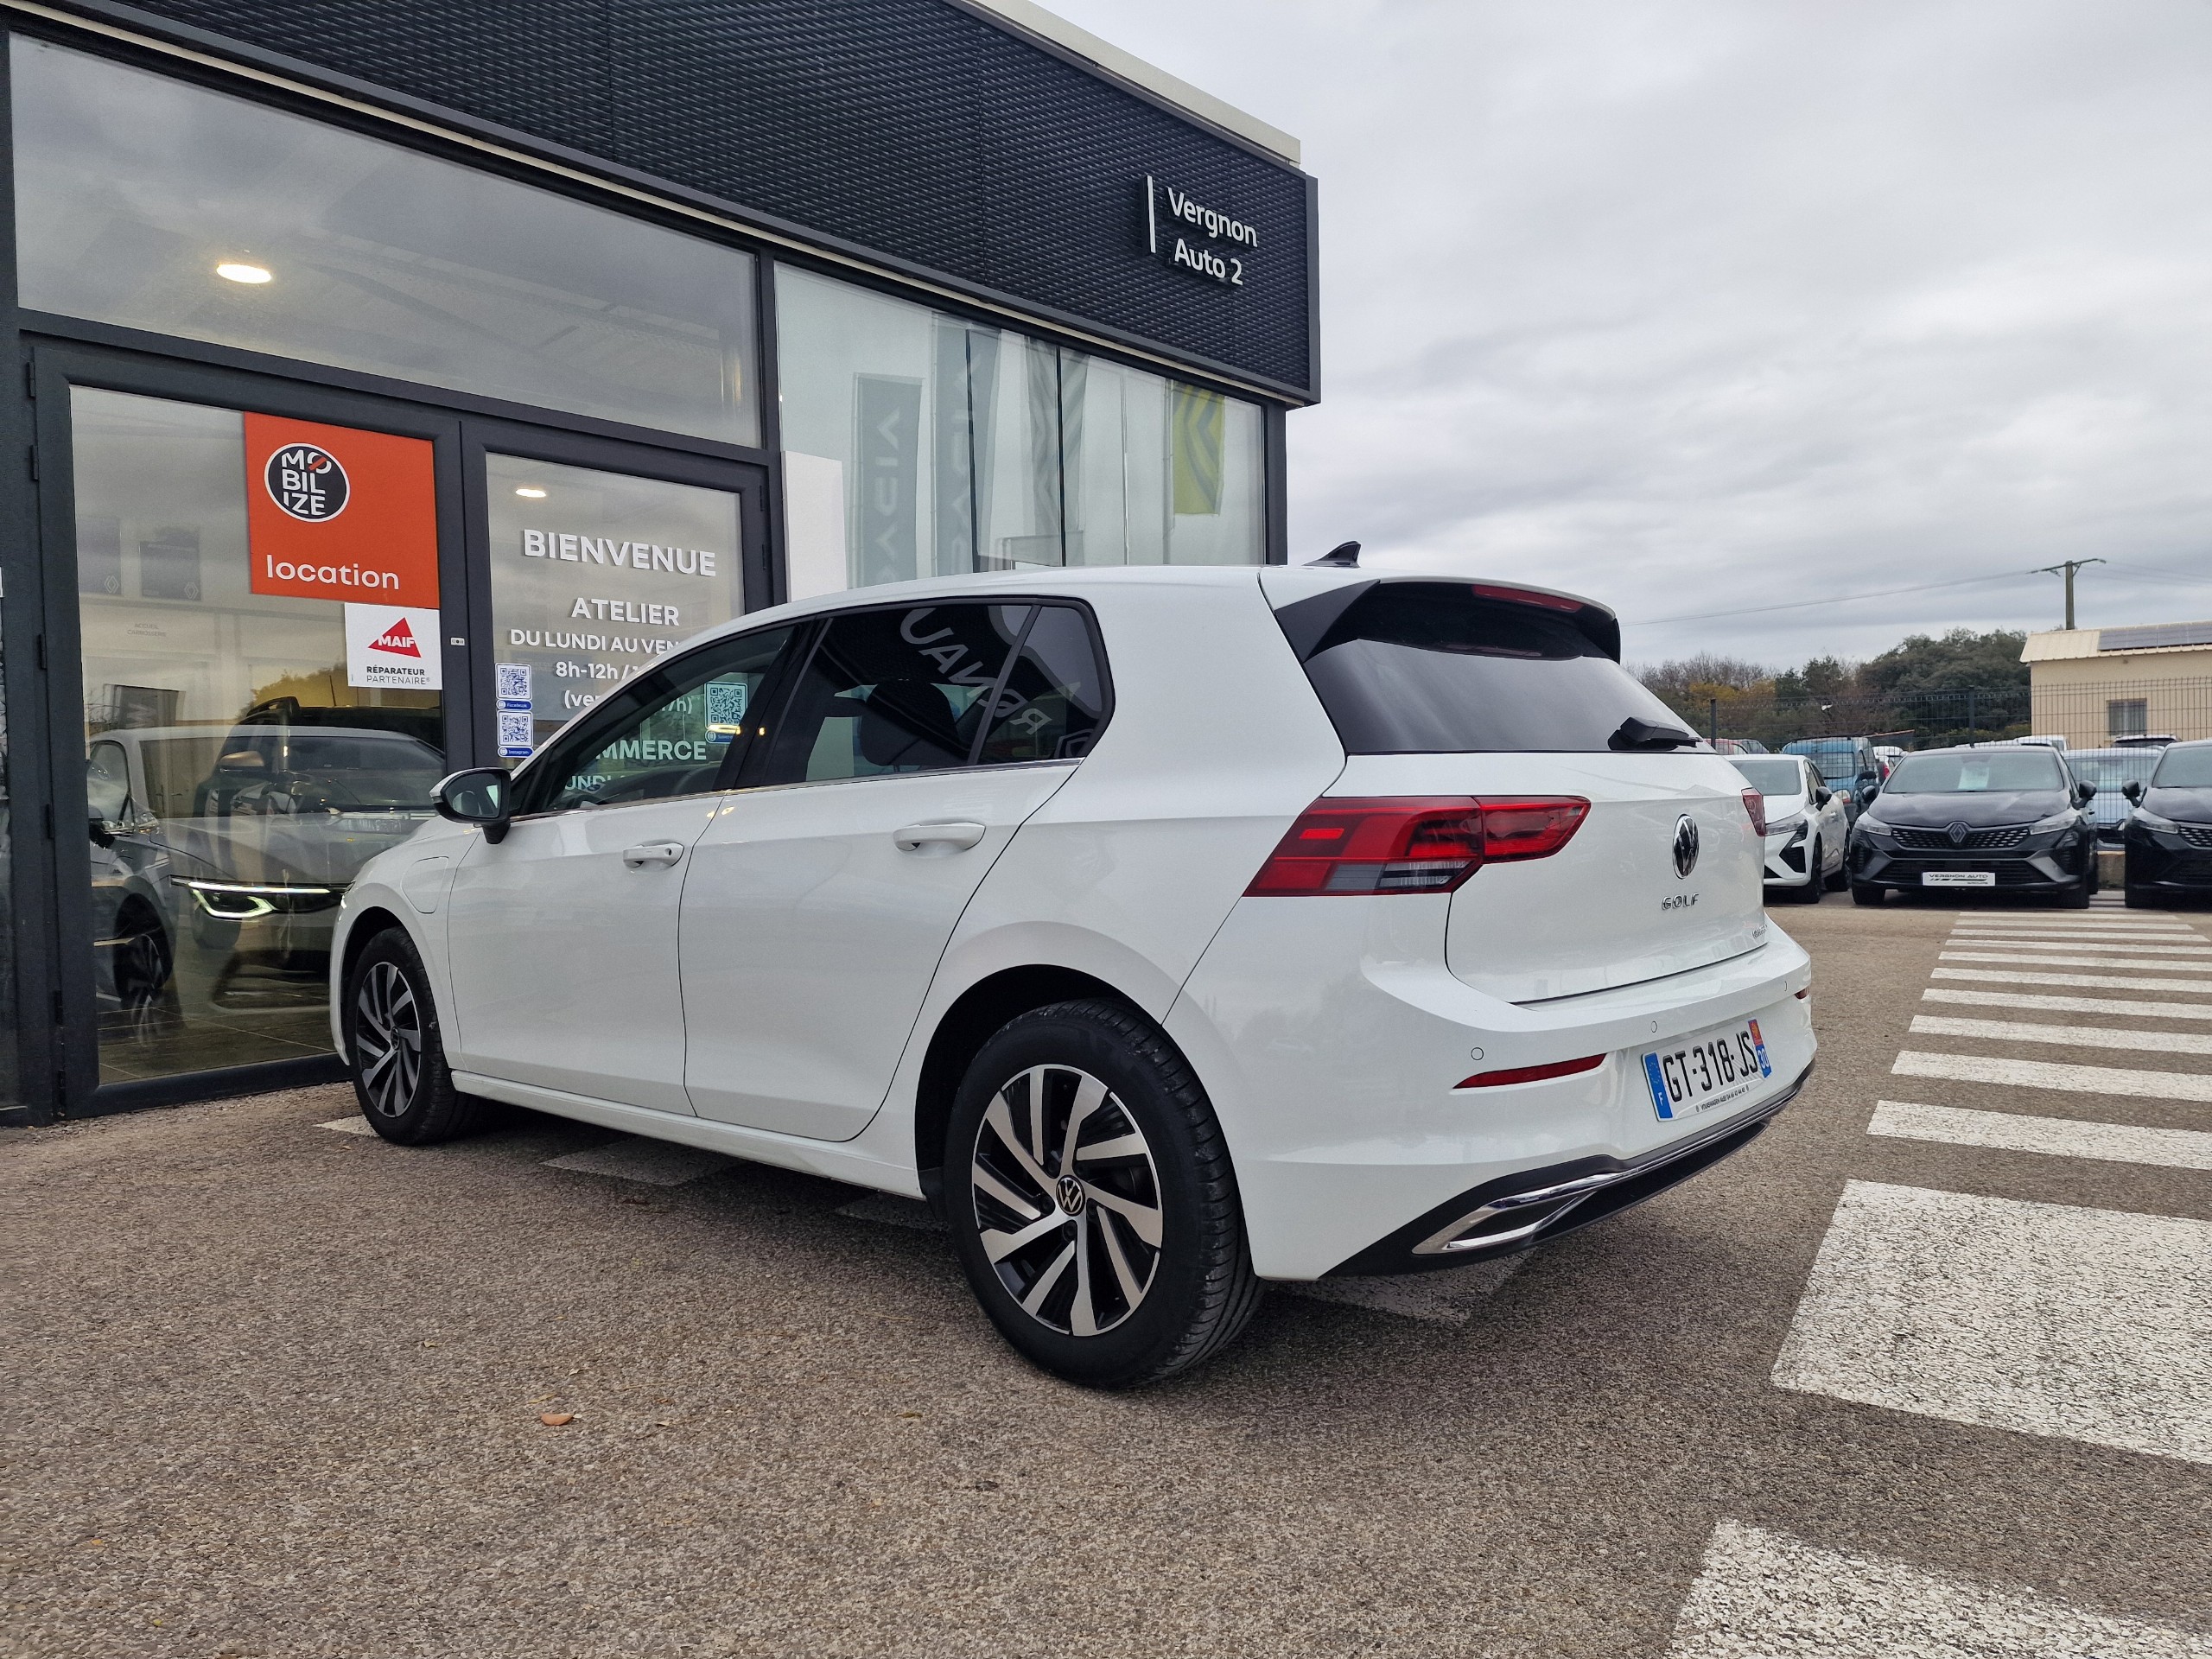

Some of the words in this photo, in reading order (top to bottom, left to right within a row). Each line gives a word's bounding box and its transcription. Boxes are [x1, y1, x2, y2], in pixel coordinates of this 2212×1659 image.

[1167, 186, 1258, 248] Vergnon
[1174, 238, 1226, 279] Auto
[1230, 258, 1243, 286] 2
[524, 529, 716, 577] BIENVENUE
[266, 554, 399, 590] location
[571, 597, 679, 626] ATELIER
[378, 635, 416, 648] MAIF
[511, 629, 540, 646] DU
[545, 631, 605, 650] LUNDI
[610, 637, 638, 652] AU
[366, 664, 425, 676] RÉPARATEUR
[556, 661, 619, 680] 8h-12h
[1661, 892, 1700, 911] GOLF
[1662, 1030, 1759, 1103] GT-318-JS
[1757, 1046, 1770, 1070] 30
[1656, 1091, 1664, 1107] F
